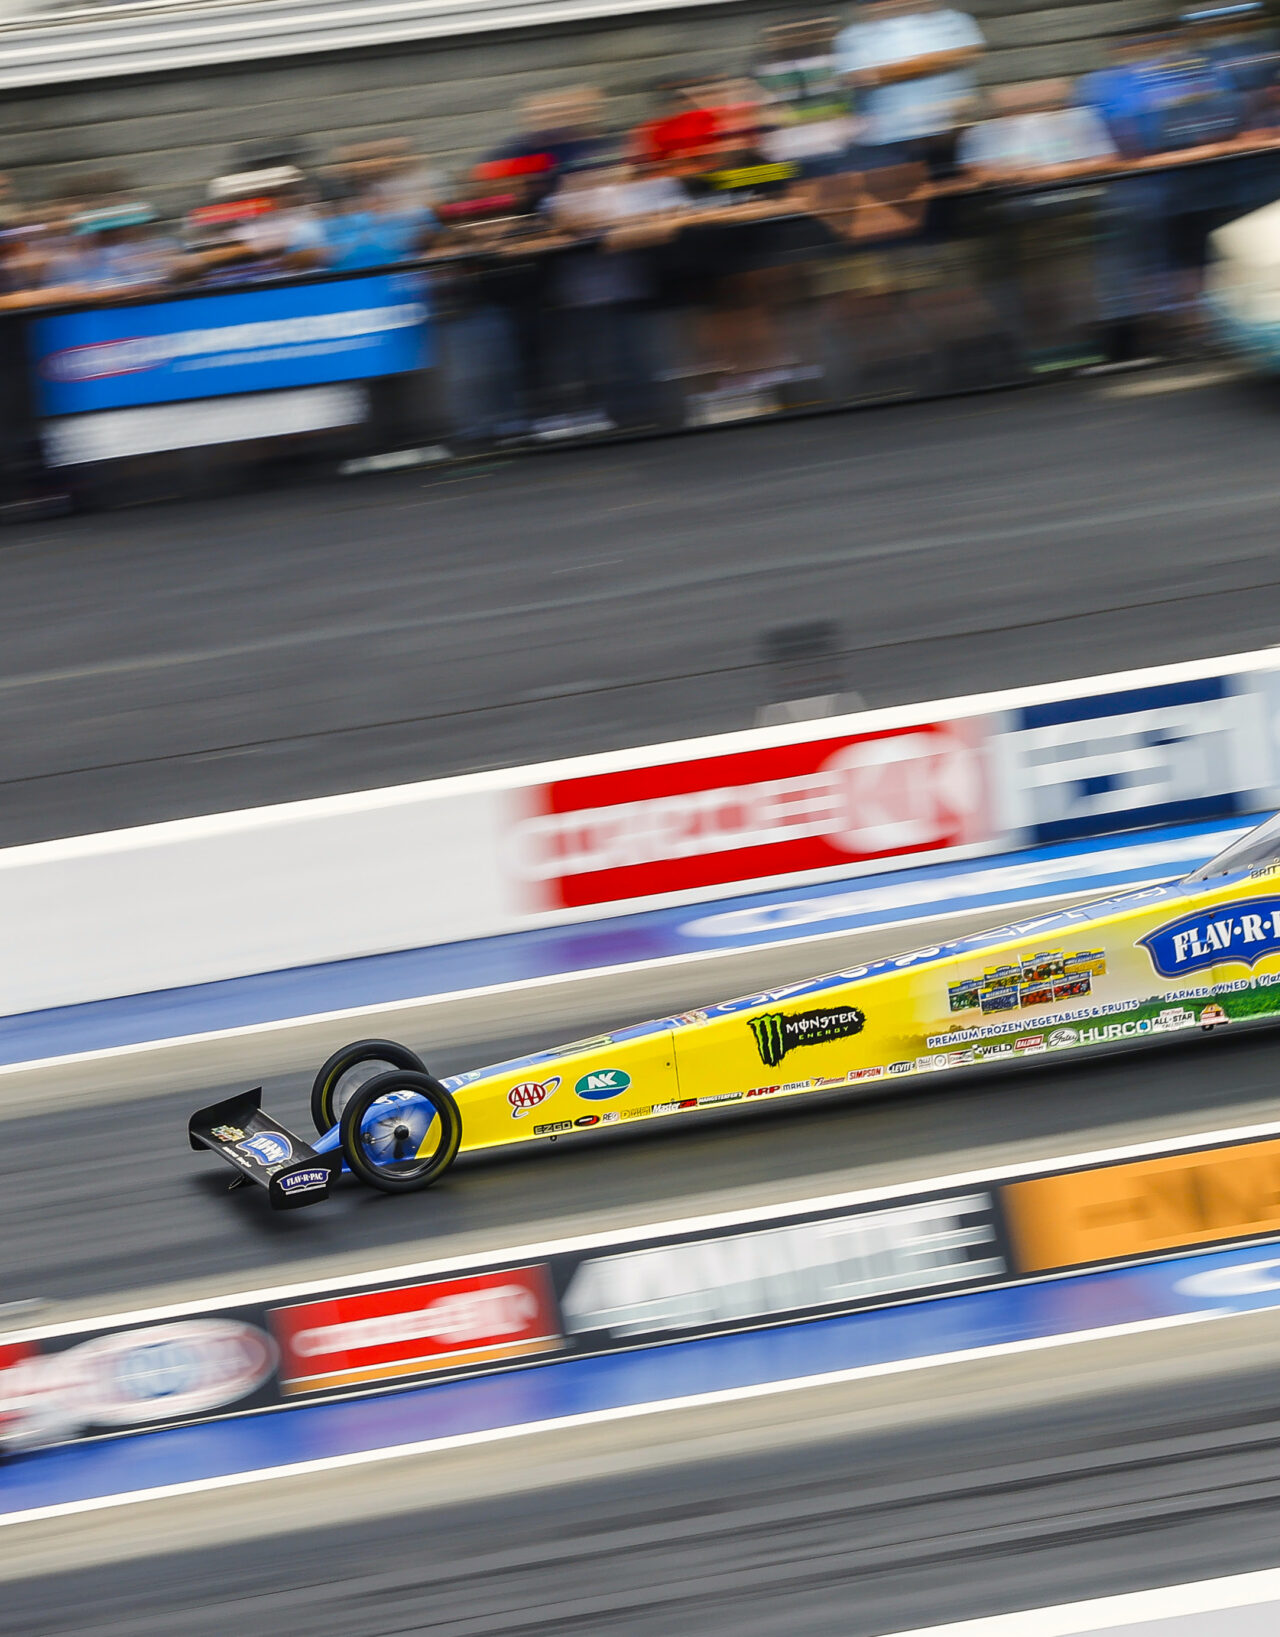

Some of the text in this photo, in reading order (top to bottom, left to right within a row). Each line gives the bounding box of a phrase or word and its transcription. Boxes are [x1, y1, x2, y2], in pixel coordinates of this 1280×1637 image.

[1165, 987, 1208, 1002] FARMER
[928, 1000, 1139, 1046] PREMIUM FROZEN VEGETABLES & FRUITS
[798, 1025, 849, 1040] ENERGY
[1079, 1020, 1151, 1043] HURCO
[982, 1043, 1013, 1055] WELD
[587, 1071, 618, 1090] NK
[848, 1066, 881, 1081] SIMPSON
[746, 1085, 781, 1098] ARP
[783, 1080, 811, 1091] MAHLE
[512, 1083, 544, 1107] AAA
